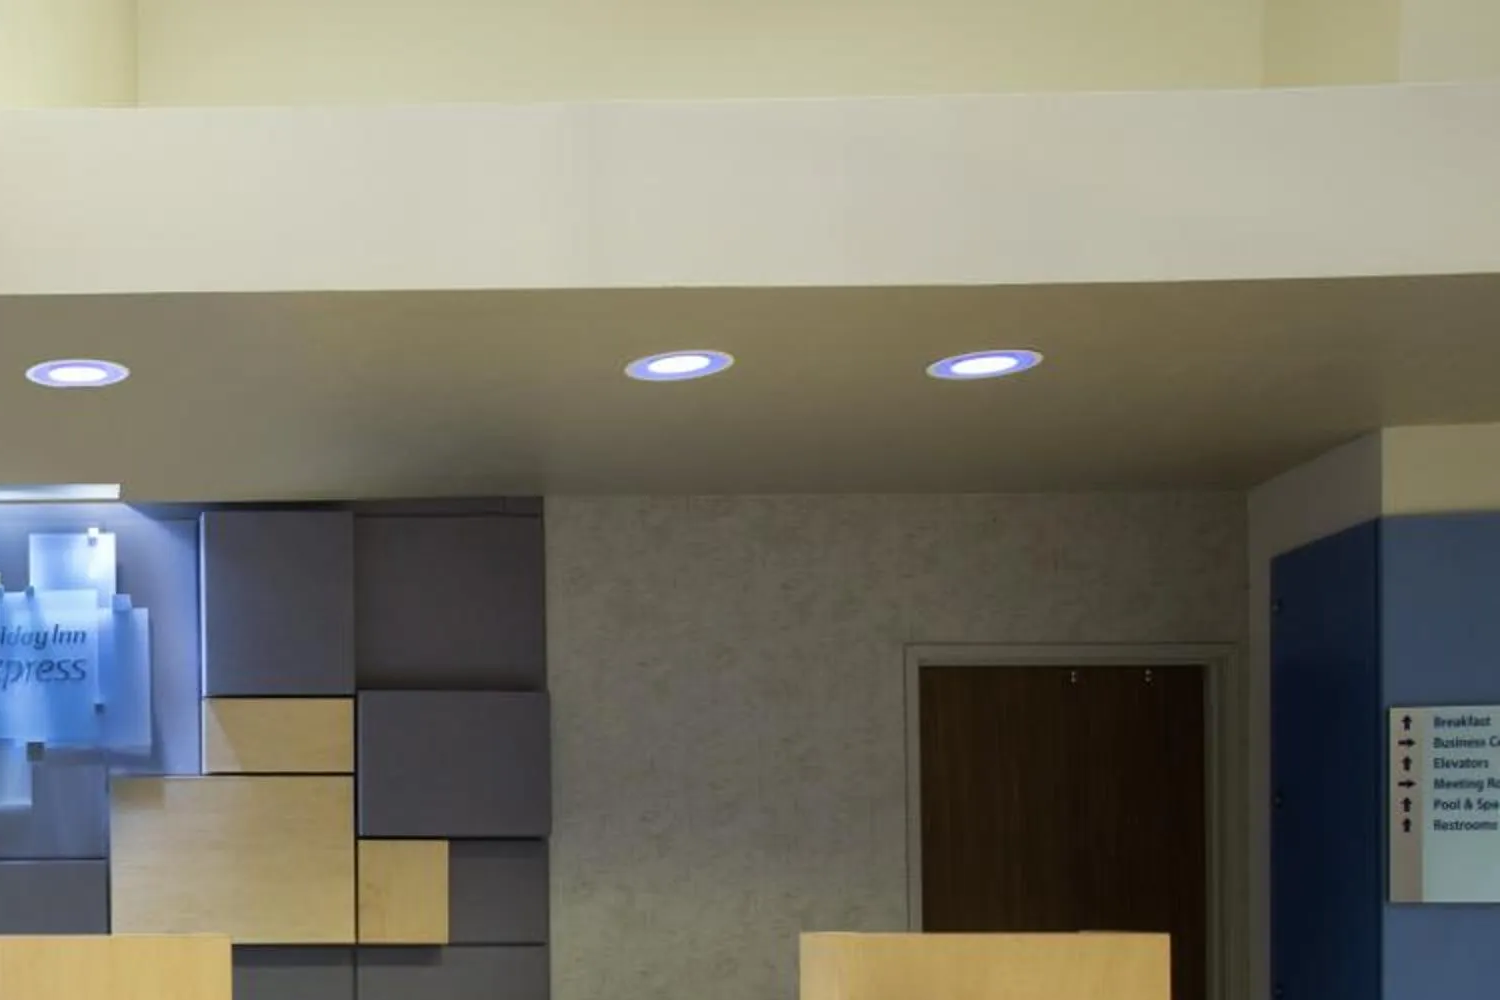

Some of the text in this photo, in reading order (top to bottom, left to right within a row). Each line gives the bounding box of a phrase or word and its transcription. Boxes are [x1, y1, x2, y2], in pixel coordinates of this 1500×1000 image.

[1433, 714, 1491, 728] Breakfast
[1433, 736, 1485, 749] Business
[1433, 757, 1489, 769] Elevators
[1433, 777, 1484, 793] Meeting
[1433, 797, 1499, 813] Pool & Spa
[1433, 818, 1498, 831] Restrooms
